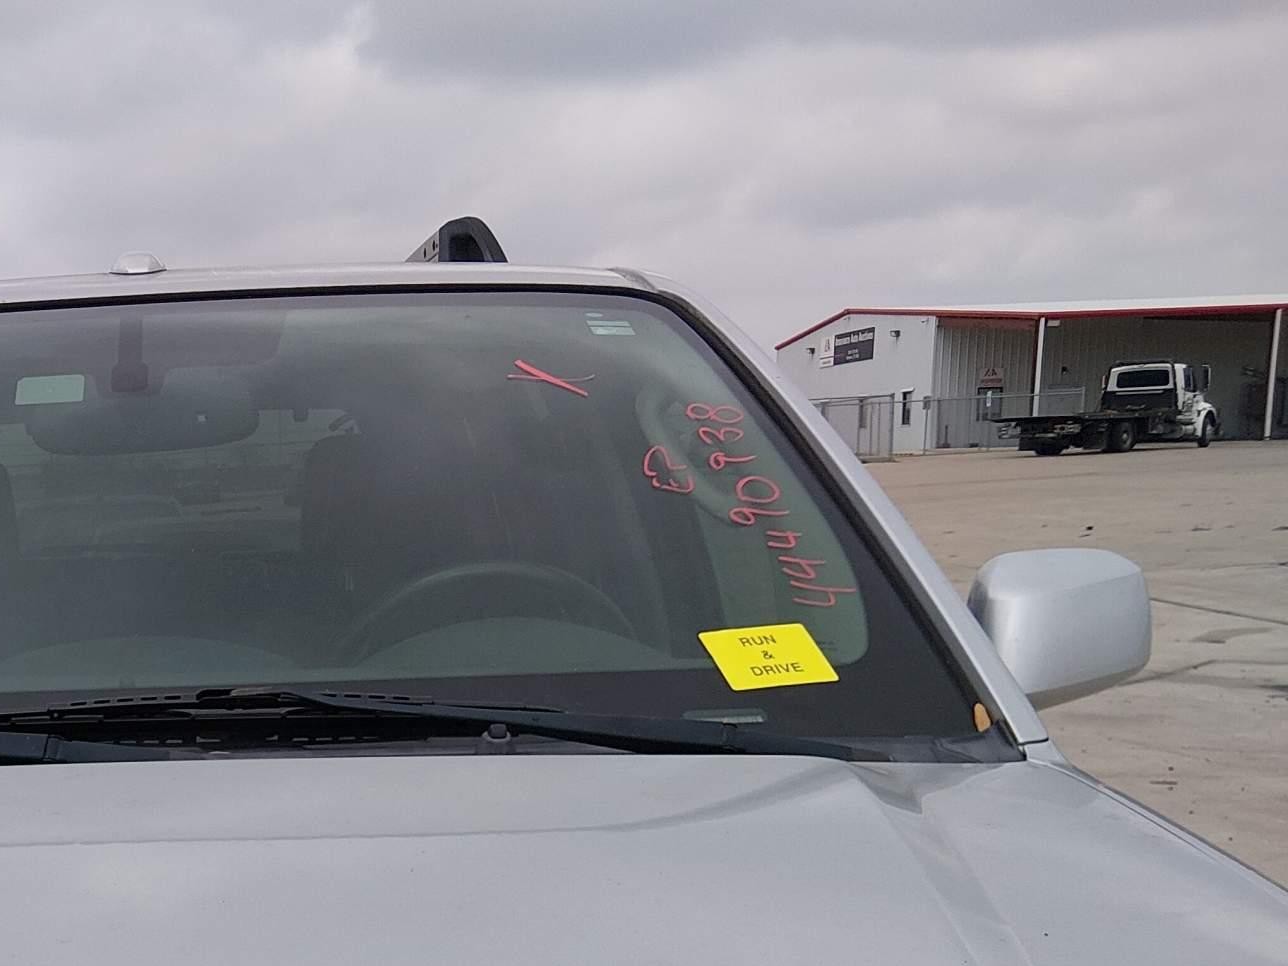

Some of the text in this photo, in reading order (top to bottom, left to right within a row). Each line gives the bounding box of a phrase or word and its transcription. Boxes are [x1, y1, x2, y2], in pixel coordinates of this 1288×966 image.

[685, 402, 857, 607] 44490938
[738, 634, 777, 647] RUN
[761, 650, 775, 659] &
[749, 662, 805, 676] DRIVE
